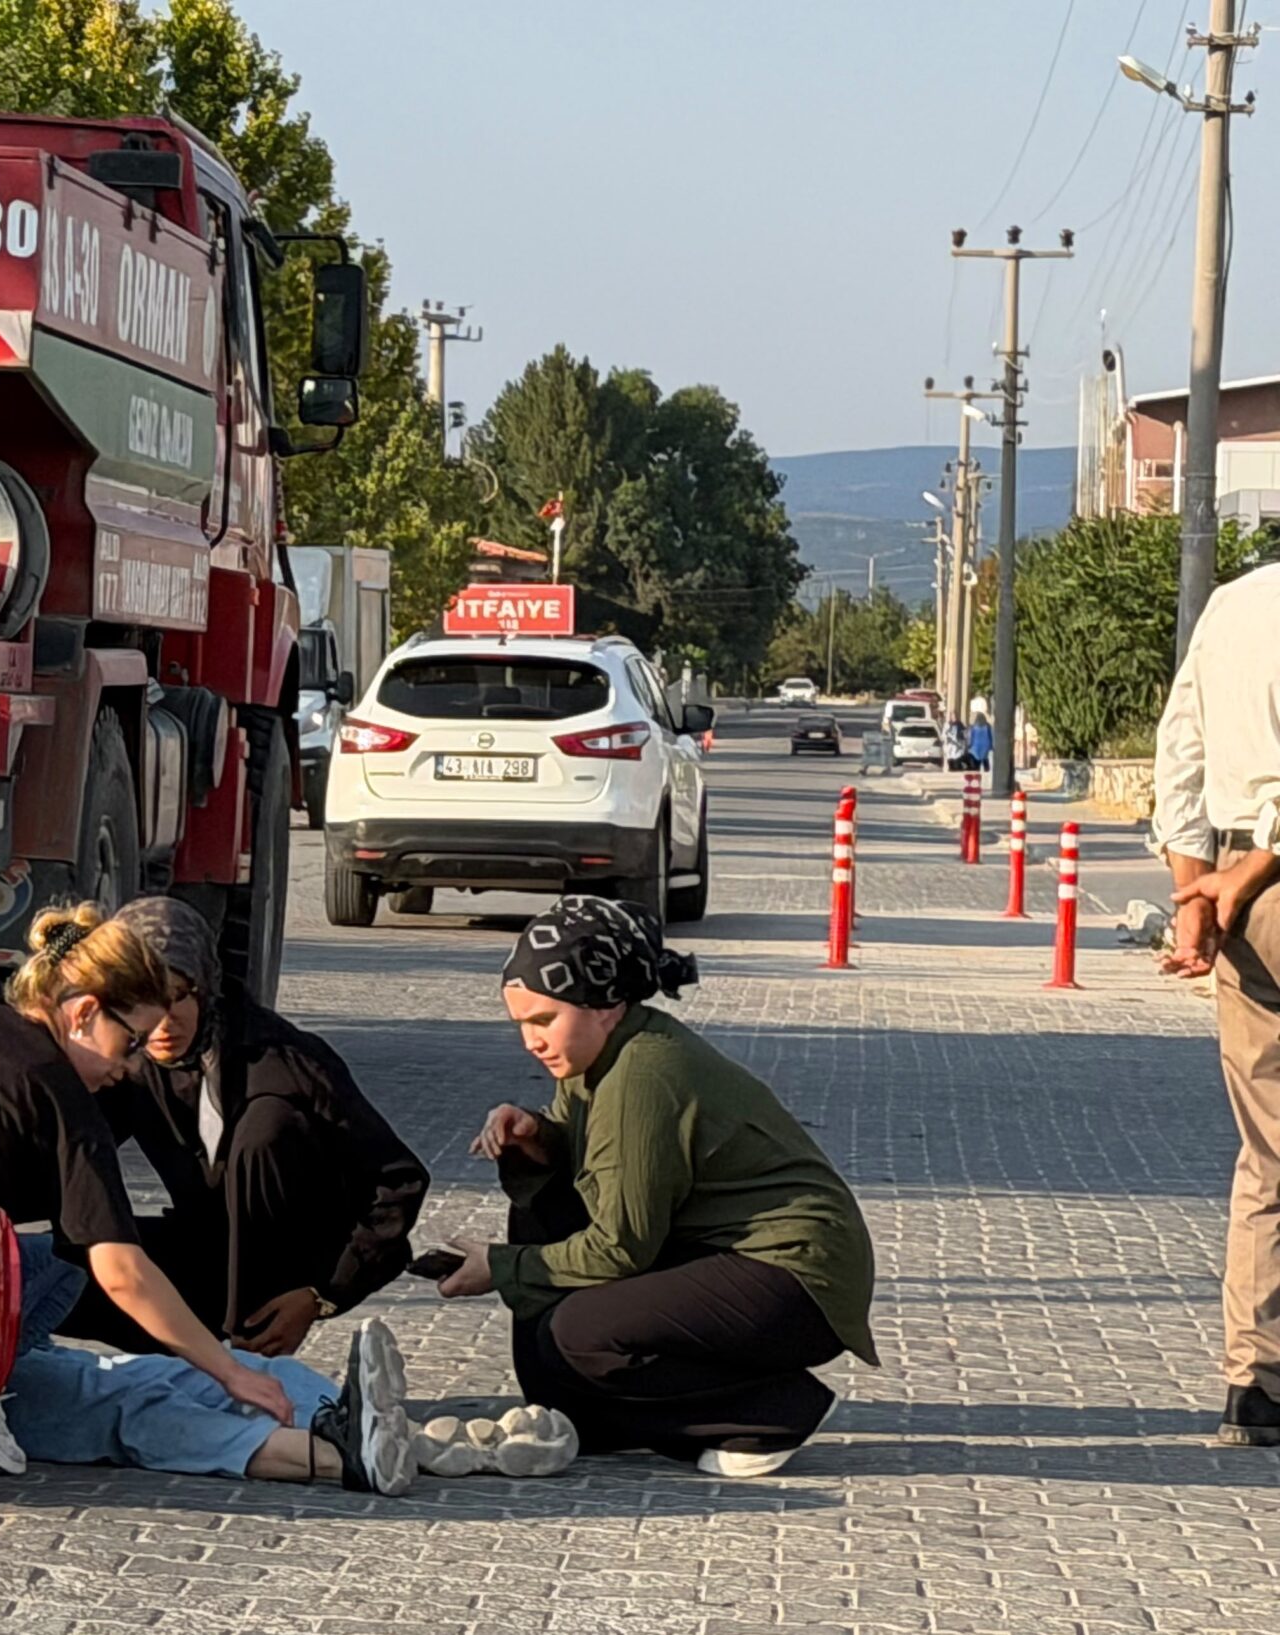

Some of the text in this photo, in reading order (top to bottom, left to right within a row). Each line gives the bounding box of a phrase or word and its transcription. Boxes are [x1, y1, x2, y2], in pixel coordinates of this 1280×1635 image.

[117, 243, 192, 367] ORMAN
[445, 758, 462, 774] 43
[503, 760, 530, 776] 298
